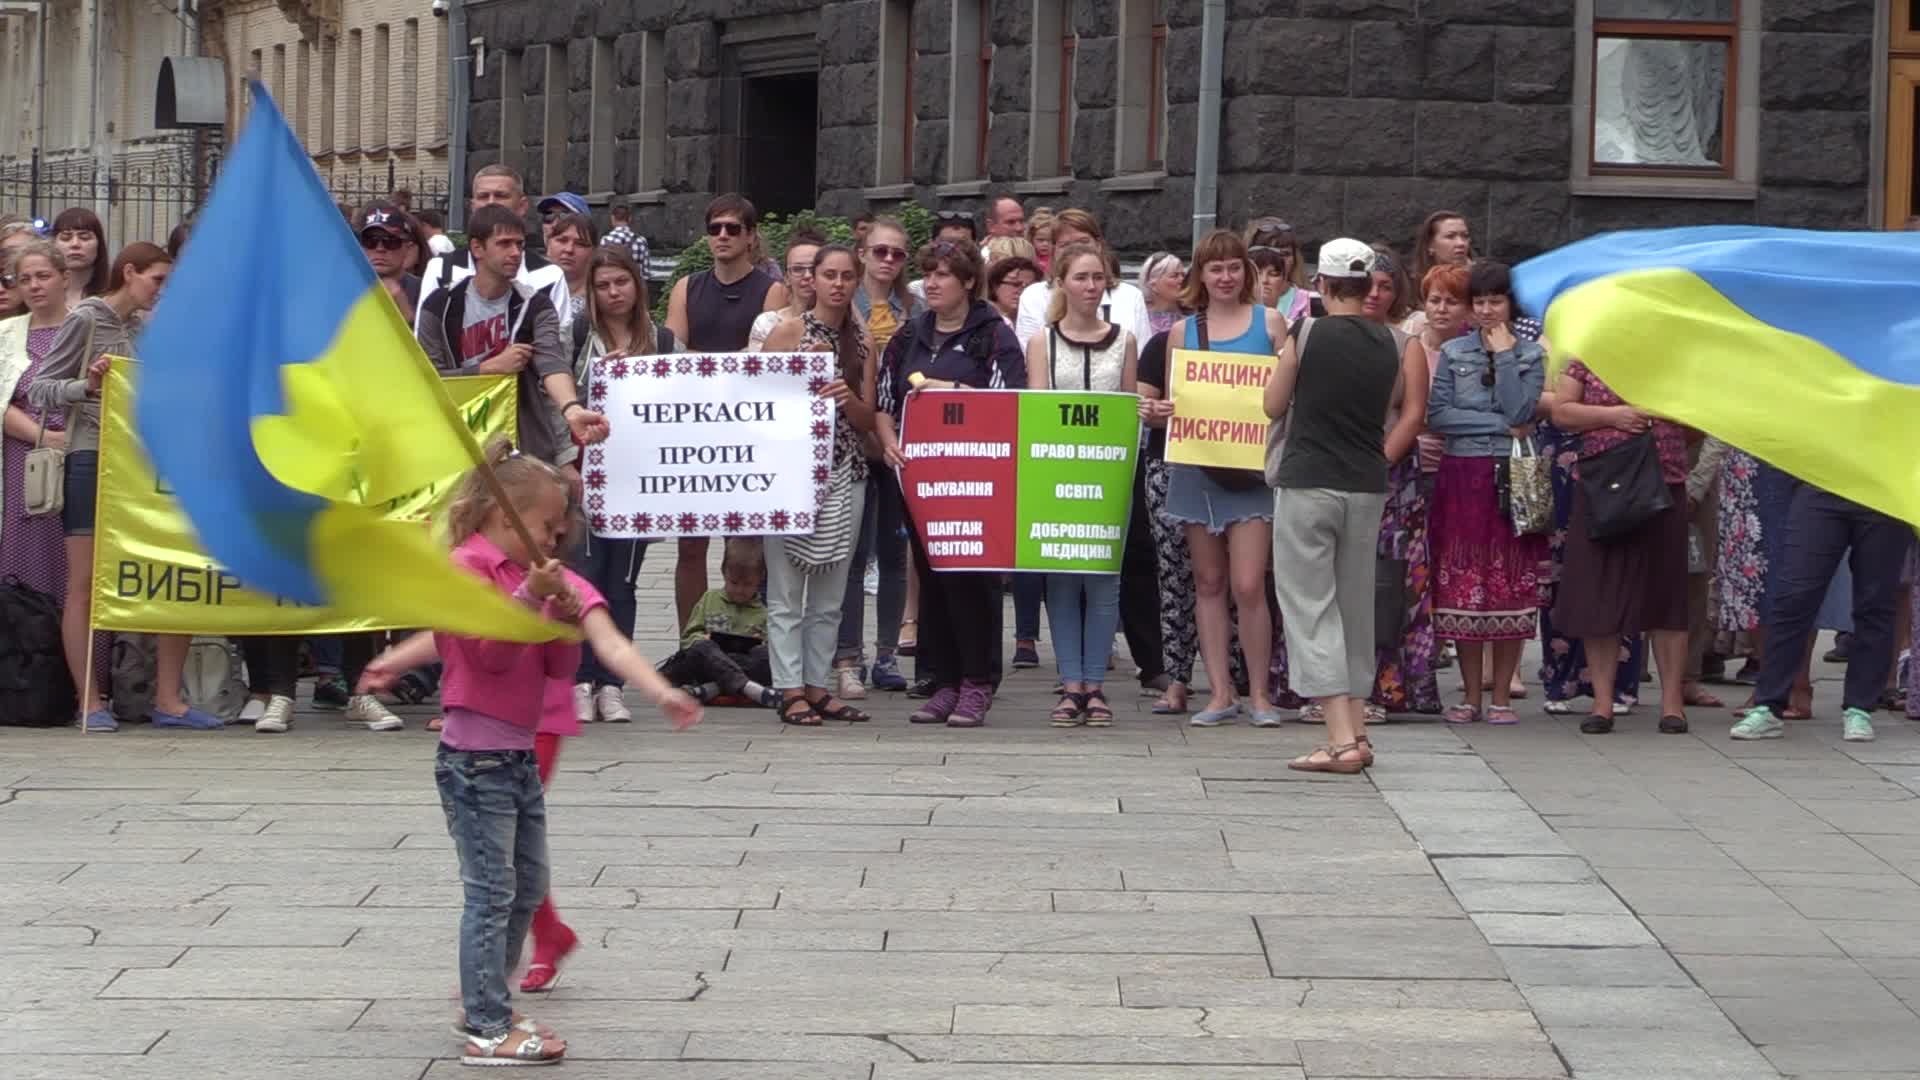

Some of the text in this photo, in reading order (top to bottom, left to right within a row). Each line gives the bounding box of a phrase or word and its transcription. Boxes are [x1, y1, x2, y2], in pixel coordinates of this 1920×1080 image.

[631, 401, 776, 424] ЧЕРКАСИ
[942, 403, 964, 425] НІ
[1058, 404, 1100, 427] ТАК
[1168, 417, 1265, 445] ДИСКРИМІ
[658, 445, 755, 465] ПРОТИ
[904, 442, 1011, 460] ДИСКРИМІНАЦІЯ
[1030, 443, 1128, 462] ПРАВО ВИБОРУ
[638, 473, 777, 494] ПРИМУСУ
[917, 481, 994, 499] ЦЬКУВАННЯ
[1055, 483, 1104, 501] ОСВІТА
[927, 521, 984, 538] ШАНТАЖ
[927, 541, 984, 557] ОСВІТОЮ
[1040, 543, 1113, 561] МЕДИЦИНА
[117, 560, 241, 606] ВИБІР
